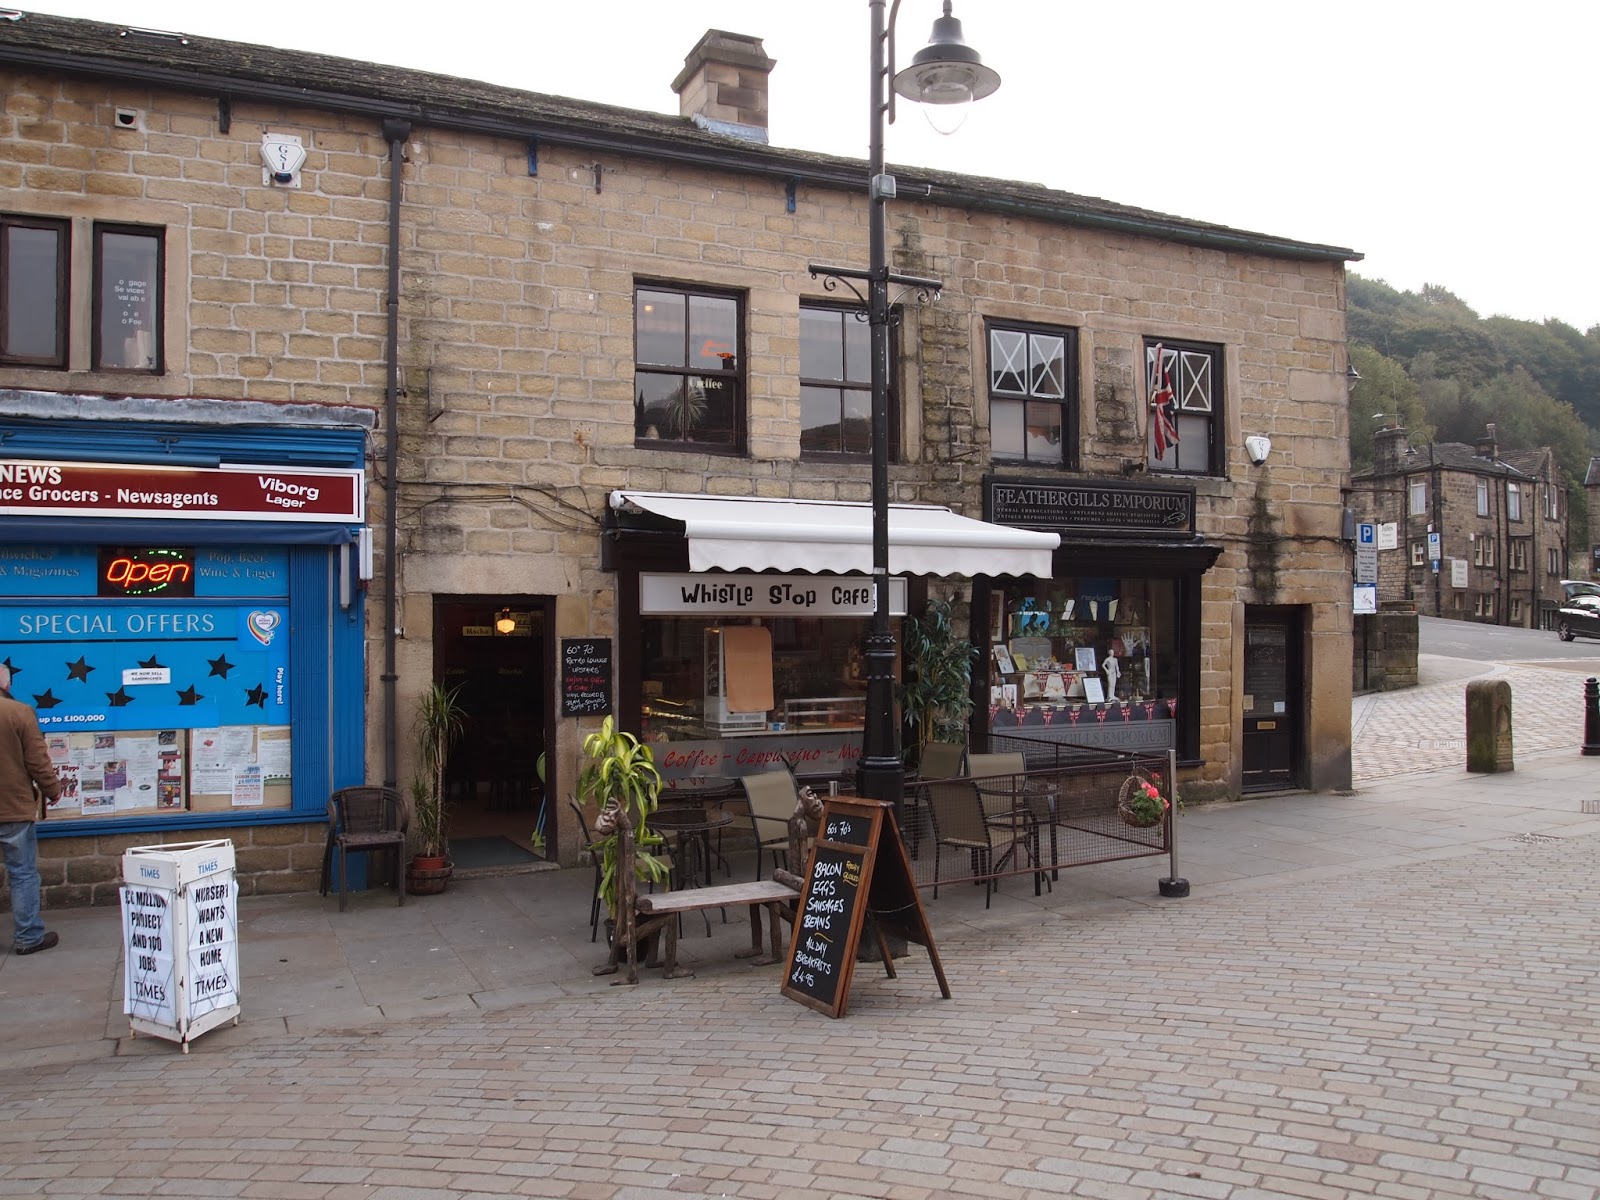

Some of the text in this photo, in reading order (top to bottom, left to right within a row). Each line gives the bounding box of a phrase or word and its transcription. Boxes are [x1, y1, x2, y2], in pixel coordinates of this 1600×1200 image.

[0, 465, 62, 485] NEWS
[29, 486, 99, 502] Grocers
[117, 488, 219, 508] Newsagents
[258, 476, 320, 501] Viborg
[265, 493, 306, 508] Lager
[996, 488, 1187, 511] FEATHERGILLS EMPORIUM
[14, 566, 80, 579] Magazines
[107, 558, 190, 588] Open
[200, 568, 228, 578] Wine
[246, 568, 276, 580] Lager
[832, 586, 869, 606] Cafe
[19, 614, 215, 634] SPECIAL OFFERS
[276, 668, 284, 684] Play
[64, 714, 105, 723] £100,000
[1102, 728, 1168, 745] EMPORIUM
[663, 749, 718, 769] Coffee
[140, 868, 160, 880] TIMES
[198, 861, 218, 874] TIMES
[814, 862, 843, 878] BACON
[812, 880, 836, 896] EGGS
[806, 897, 844, 914] SAUSAGES
[199, 906, 226, 924] WANTS
[804, 914, 831, 930] BEANS
[133, 933, 147, 949] AND
[200, 927, 224, 946] A NEW
[138, 955, 157, 972] JOBS
[200, 948, 222, 968] HOME
[134, 981, 165, 1001] TIMES
[195, 974, 227, 996] TIMES
